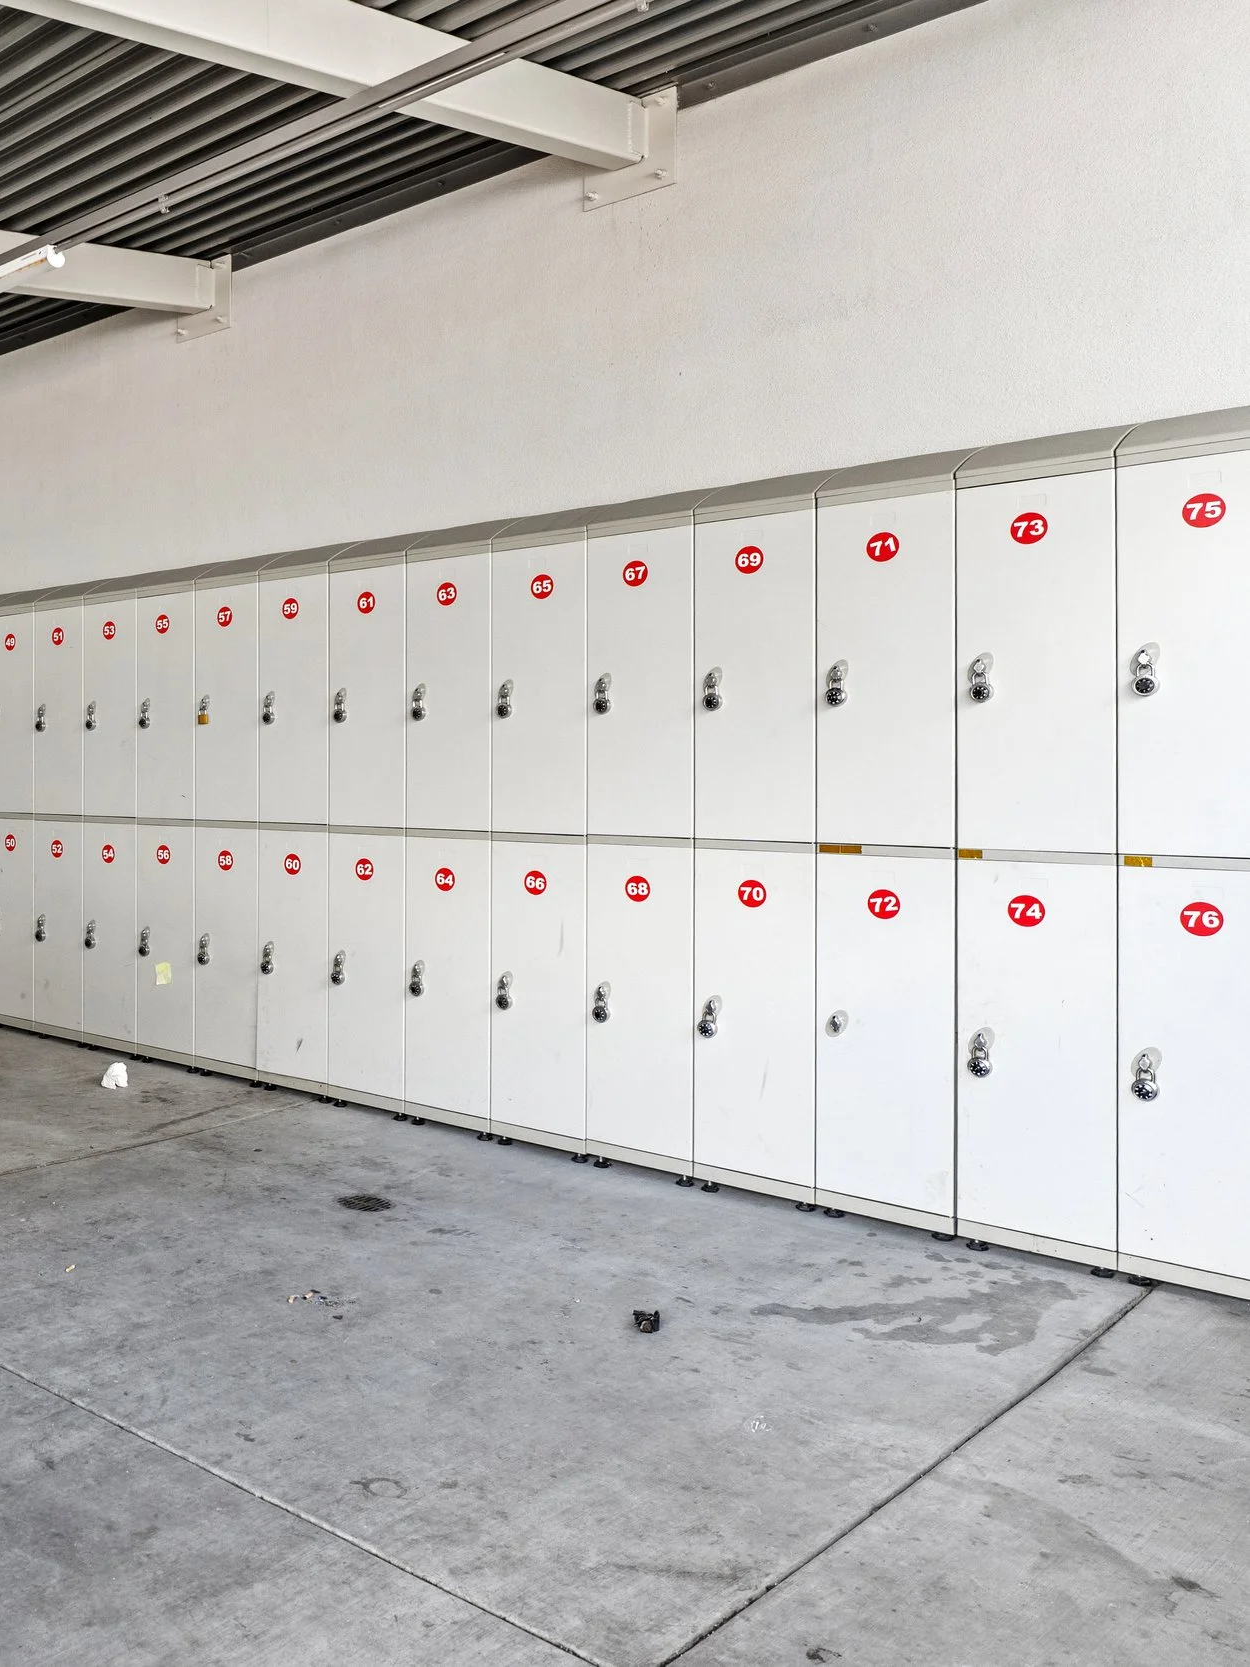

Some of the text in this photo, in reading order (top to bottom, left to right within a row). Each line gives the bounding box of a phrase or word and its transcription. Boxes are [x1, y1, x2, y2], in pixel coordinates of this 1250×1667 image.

[1185, 500, 1222, 521] 75
[1013, 519, 1045, 538] 73
[869, 536, 897, 557] 71
[737, 552, 762, 568] 69
[624, 565, 646, 582] 67
[532, 579, 552, 594] 65
[437, 586, 456, 602] 63
[283, 602, 298, 615] 59
[358, 595, 374, 609] 61
[218, 610, 232, 623] 57
[103, 625, 115, 636] 53
[156, 618, 169, 630] 55
[5, 637, 16, 647] 49
[53, 630, 63, 642] 51
[5, 837, 16, 848] 50
[51, 843, 63, 854] 52
[102, 847, 115, 860] 54
[157, 849, 170, 861] 56
[219, 854, 233, 867] 58
[285, 858, 300, 871] 60
[356, 863, 373, 876] 62
[435, 872, 454, 887] 64
[525, 875, 546, 891] 66
[626, 882, 649, 896] 68
[739, 886, 765, 902] 70
[869, 895, 899, 913] 72
[1010, 902, 1043, 920] 74
[1183, 910, 1221, 929] 76
